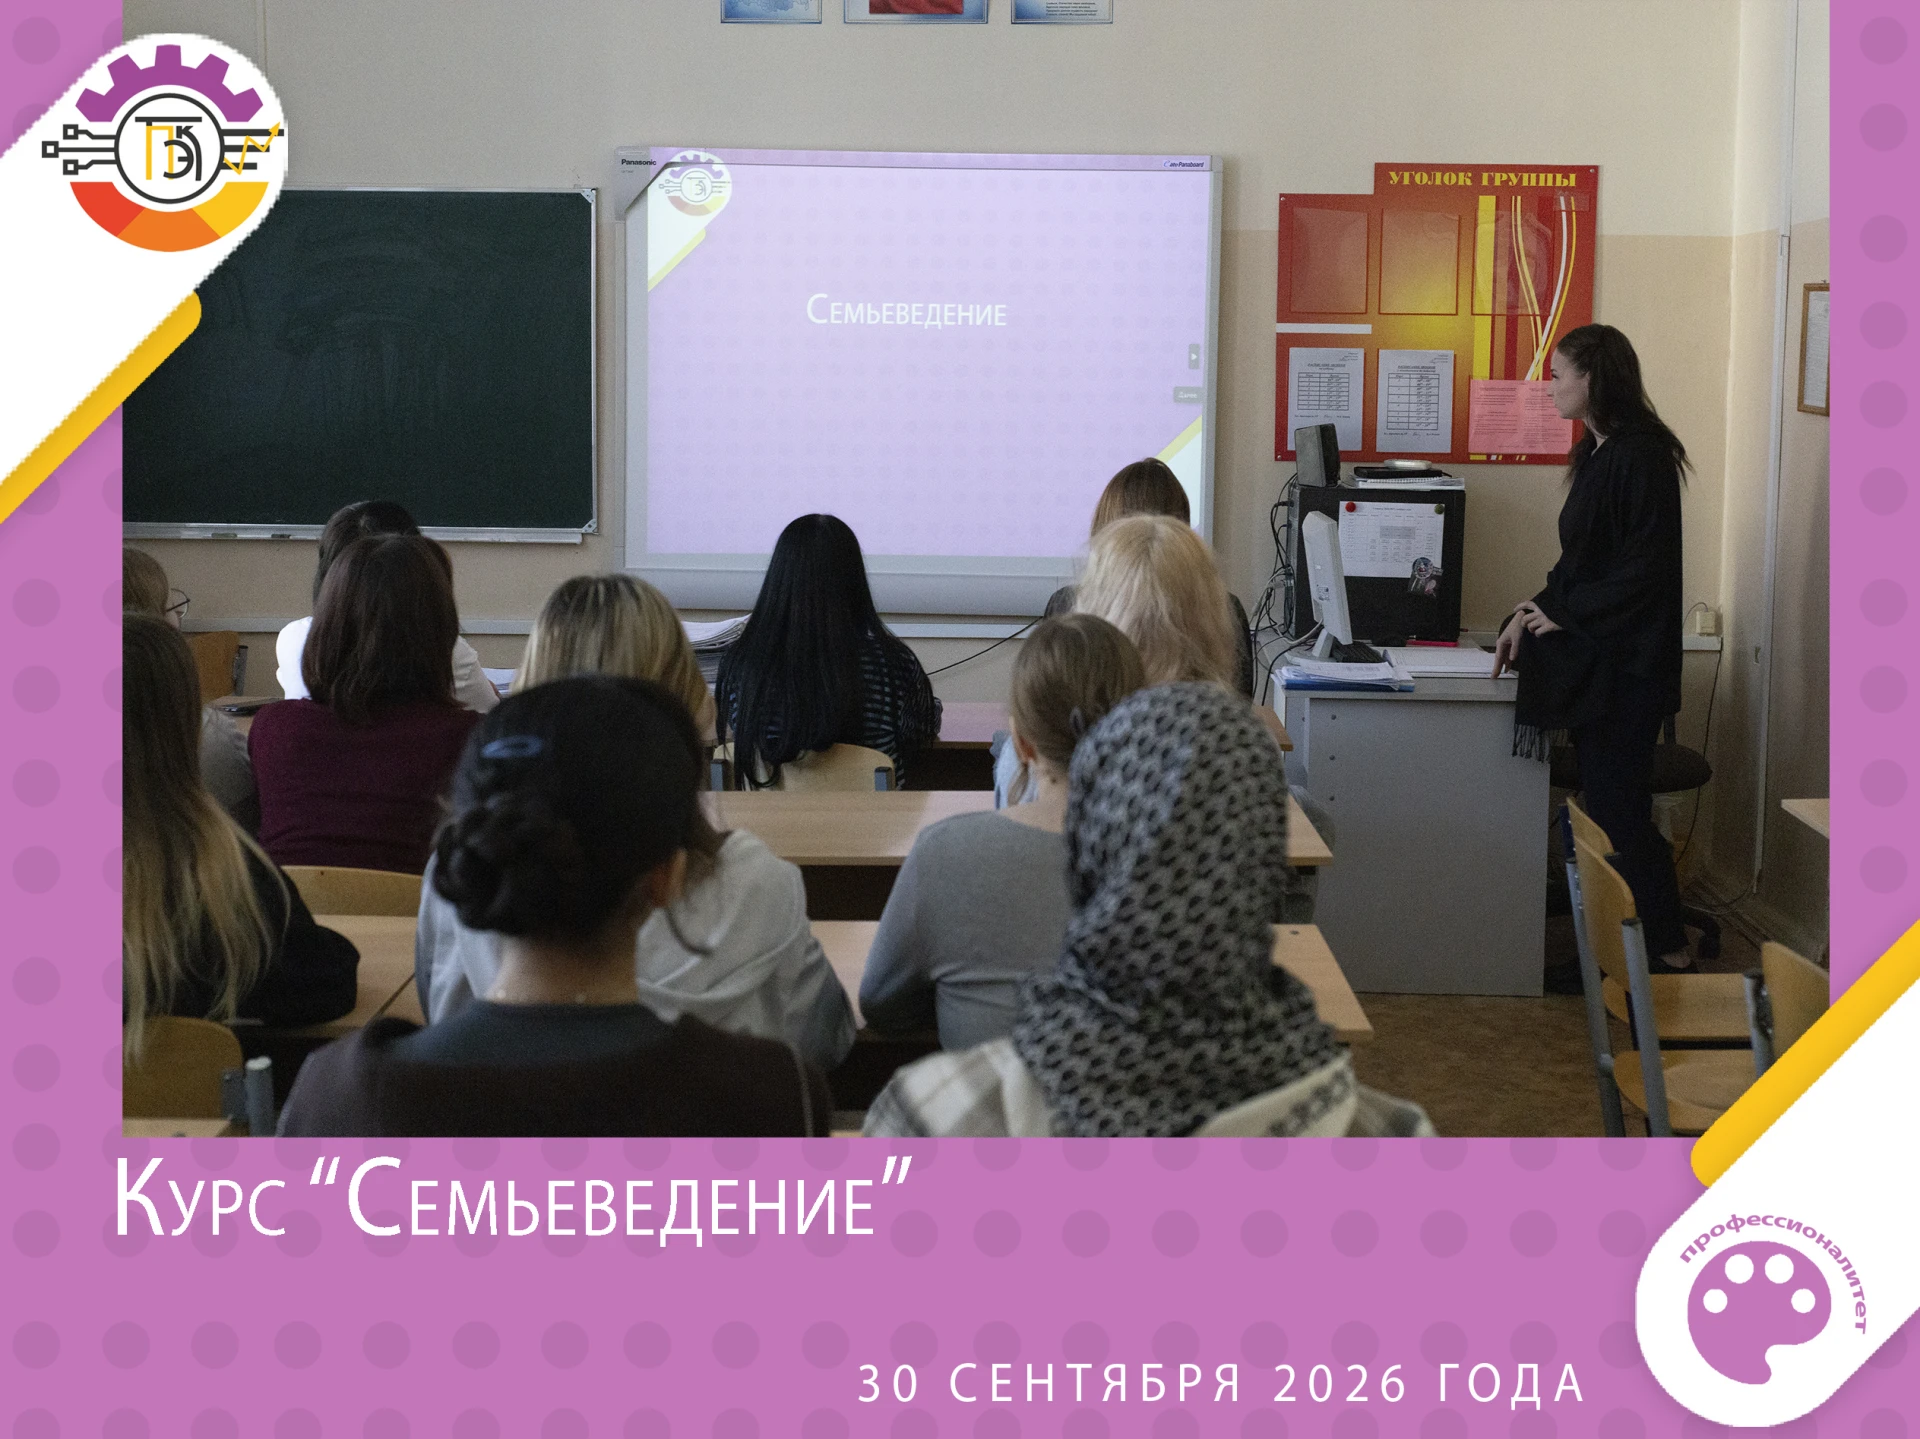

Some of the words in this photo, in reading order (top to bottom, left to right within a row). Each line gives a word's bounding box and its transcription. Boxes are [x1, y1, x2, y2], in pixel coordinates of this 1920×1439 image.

[621, 158, 657, 166] Panasonic
[1389, 172, 1472, 185] УГОЛОК
[1482, 172, 1575, 186] ГРУППЫ
